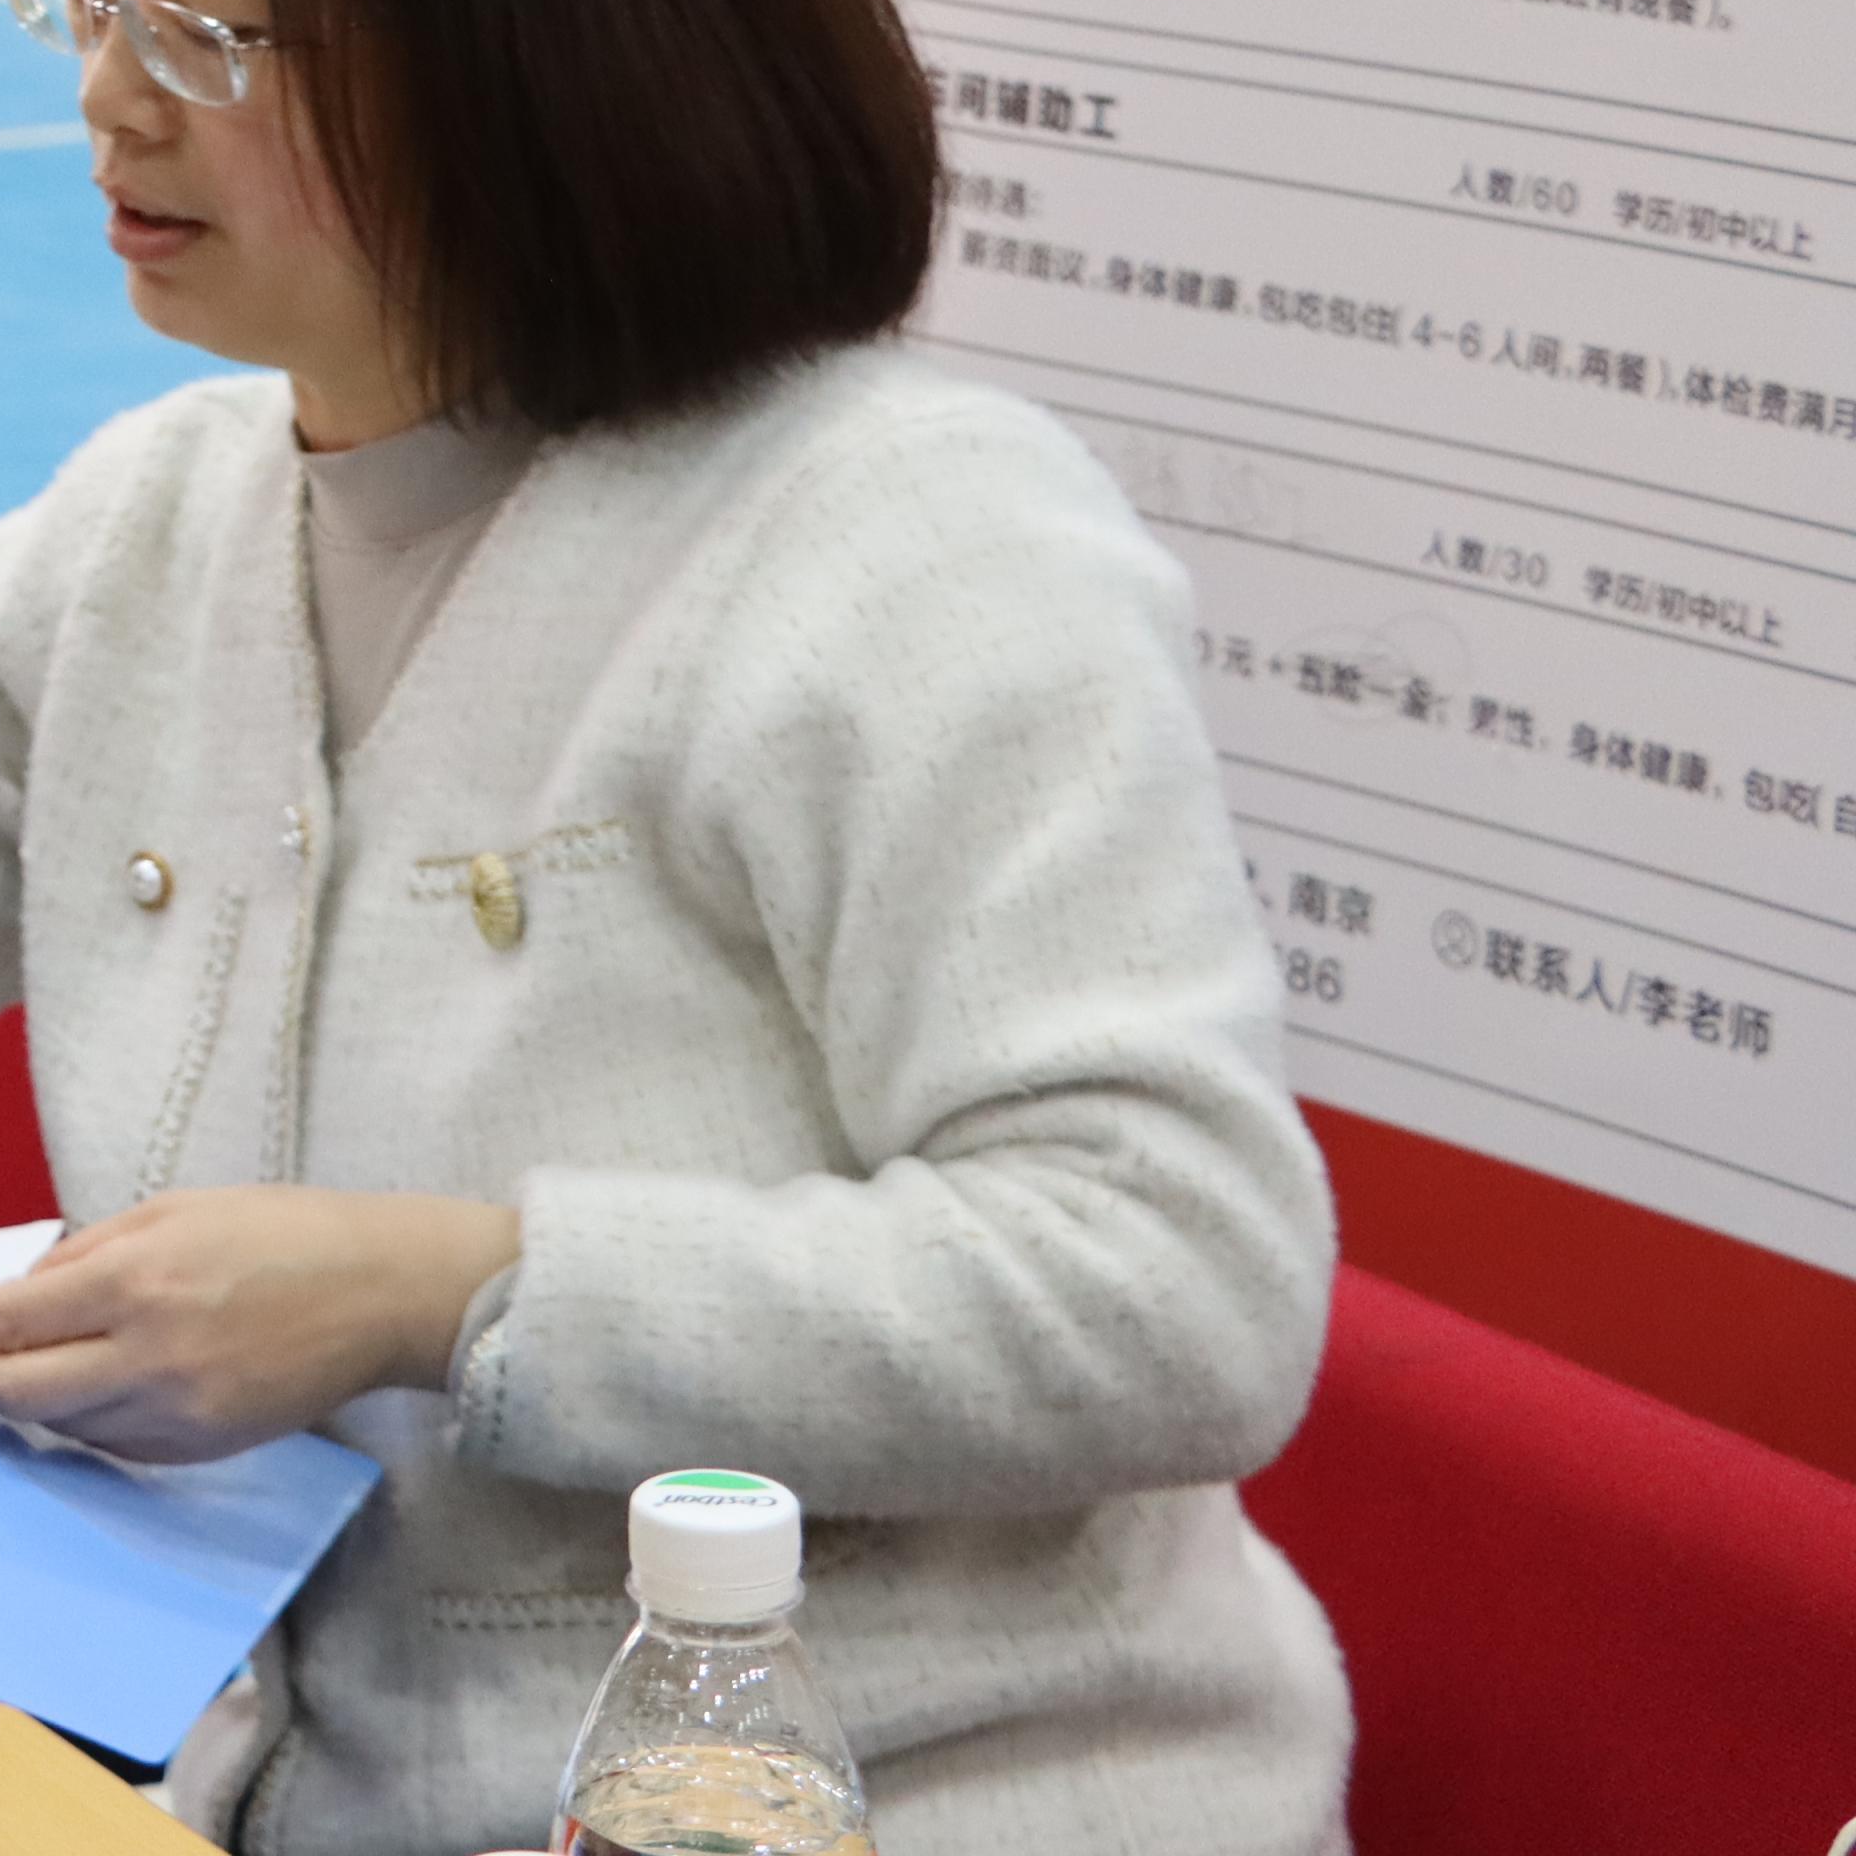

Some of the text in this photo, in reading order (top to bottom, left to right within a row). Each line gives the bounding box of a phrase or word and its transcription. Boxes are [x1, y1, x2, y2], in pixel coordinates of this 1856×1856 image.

[1273, 943, 1343, 1004] 86
[1483, 928, 1774, 1057] 联系人/李老师
